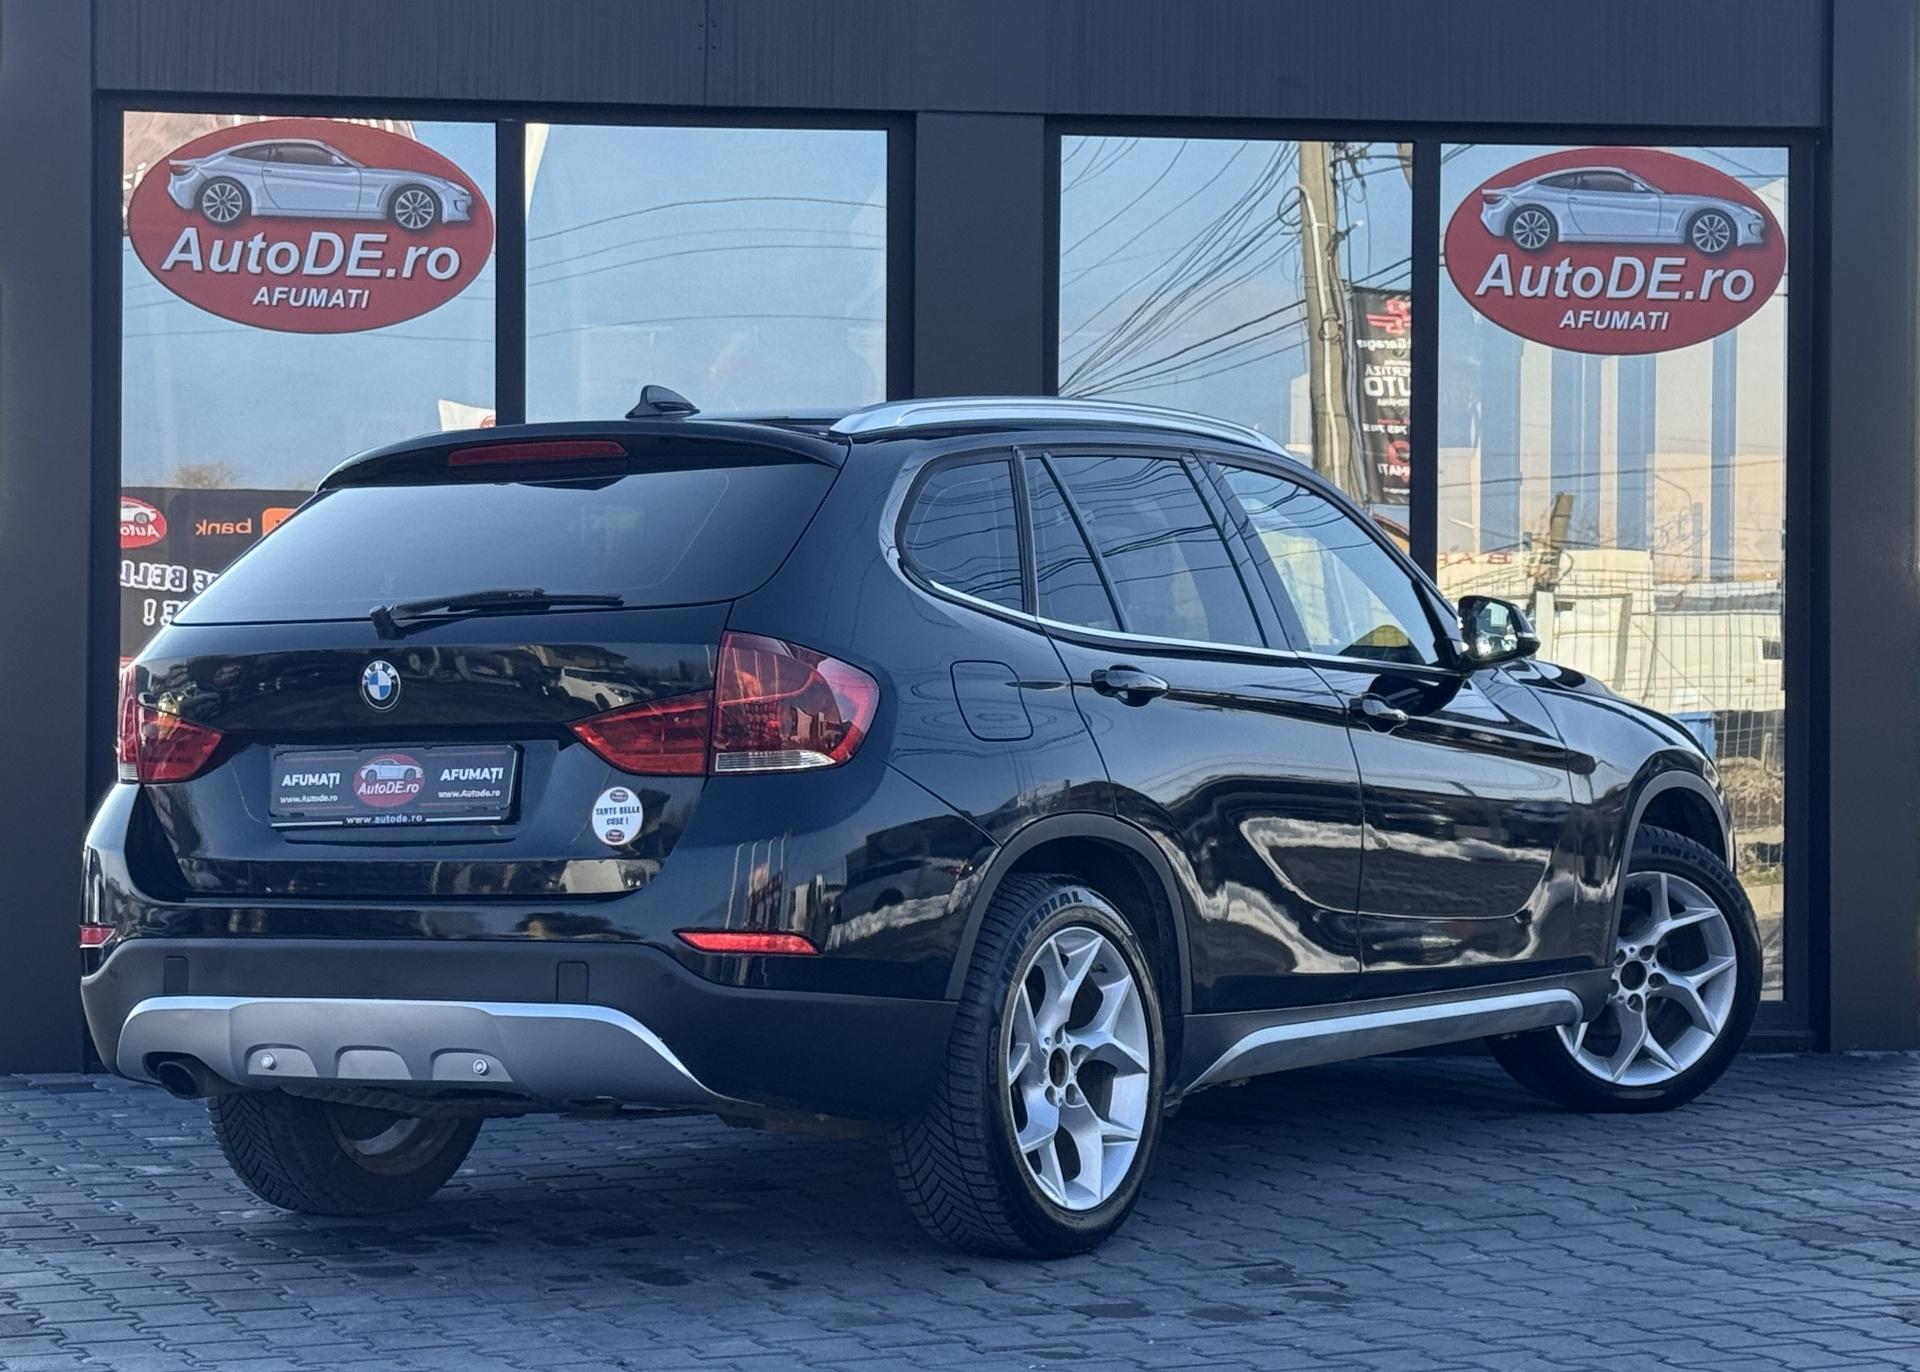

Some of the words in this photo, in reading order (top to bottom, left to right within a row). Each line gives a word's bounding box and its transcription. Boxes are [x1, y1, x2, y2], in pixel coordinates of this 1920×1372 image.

[161, 226, 460, 281] AutoDE.ro
[1475, 254, 1754, 301] AutoDE.ro
[252, 286, 369, 309] AFUMATI
[1559, 309, 1669, 331] AFUMATI
[357, 781, 420, 795] AutoDE.ro
[346, 814, 423, 825] www.autode.ro
